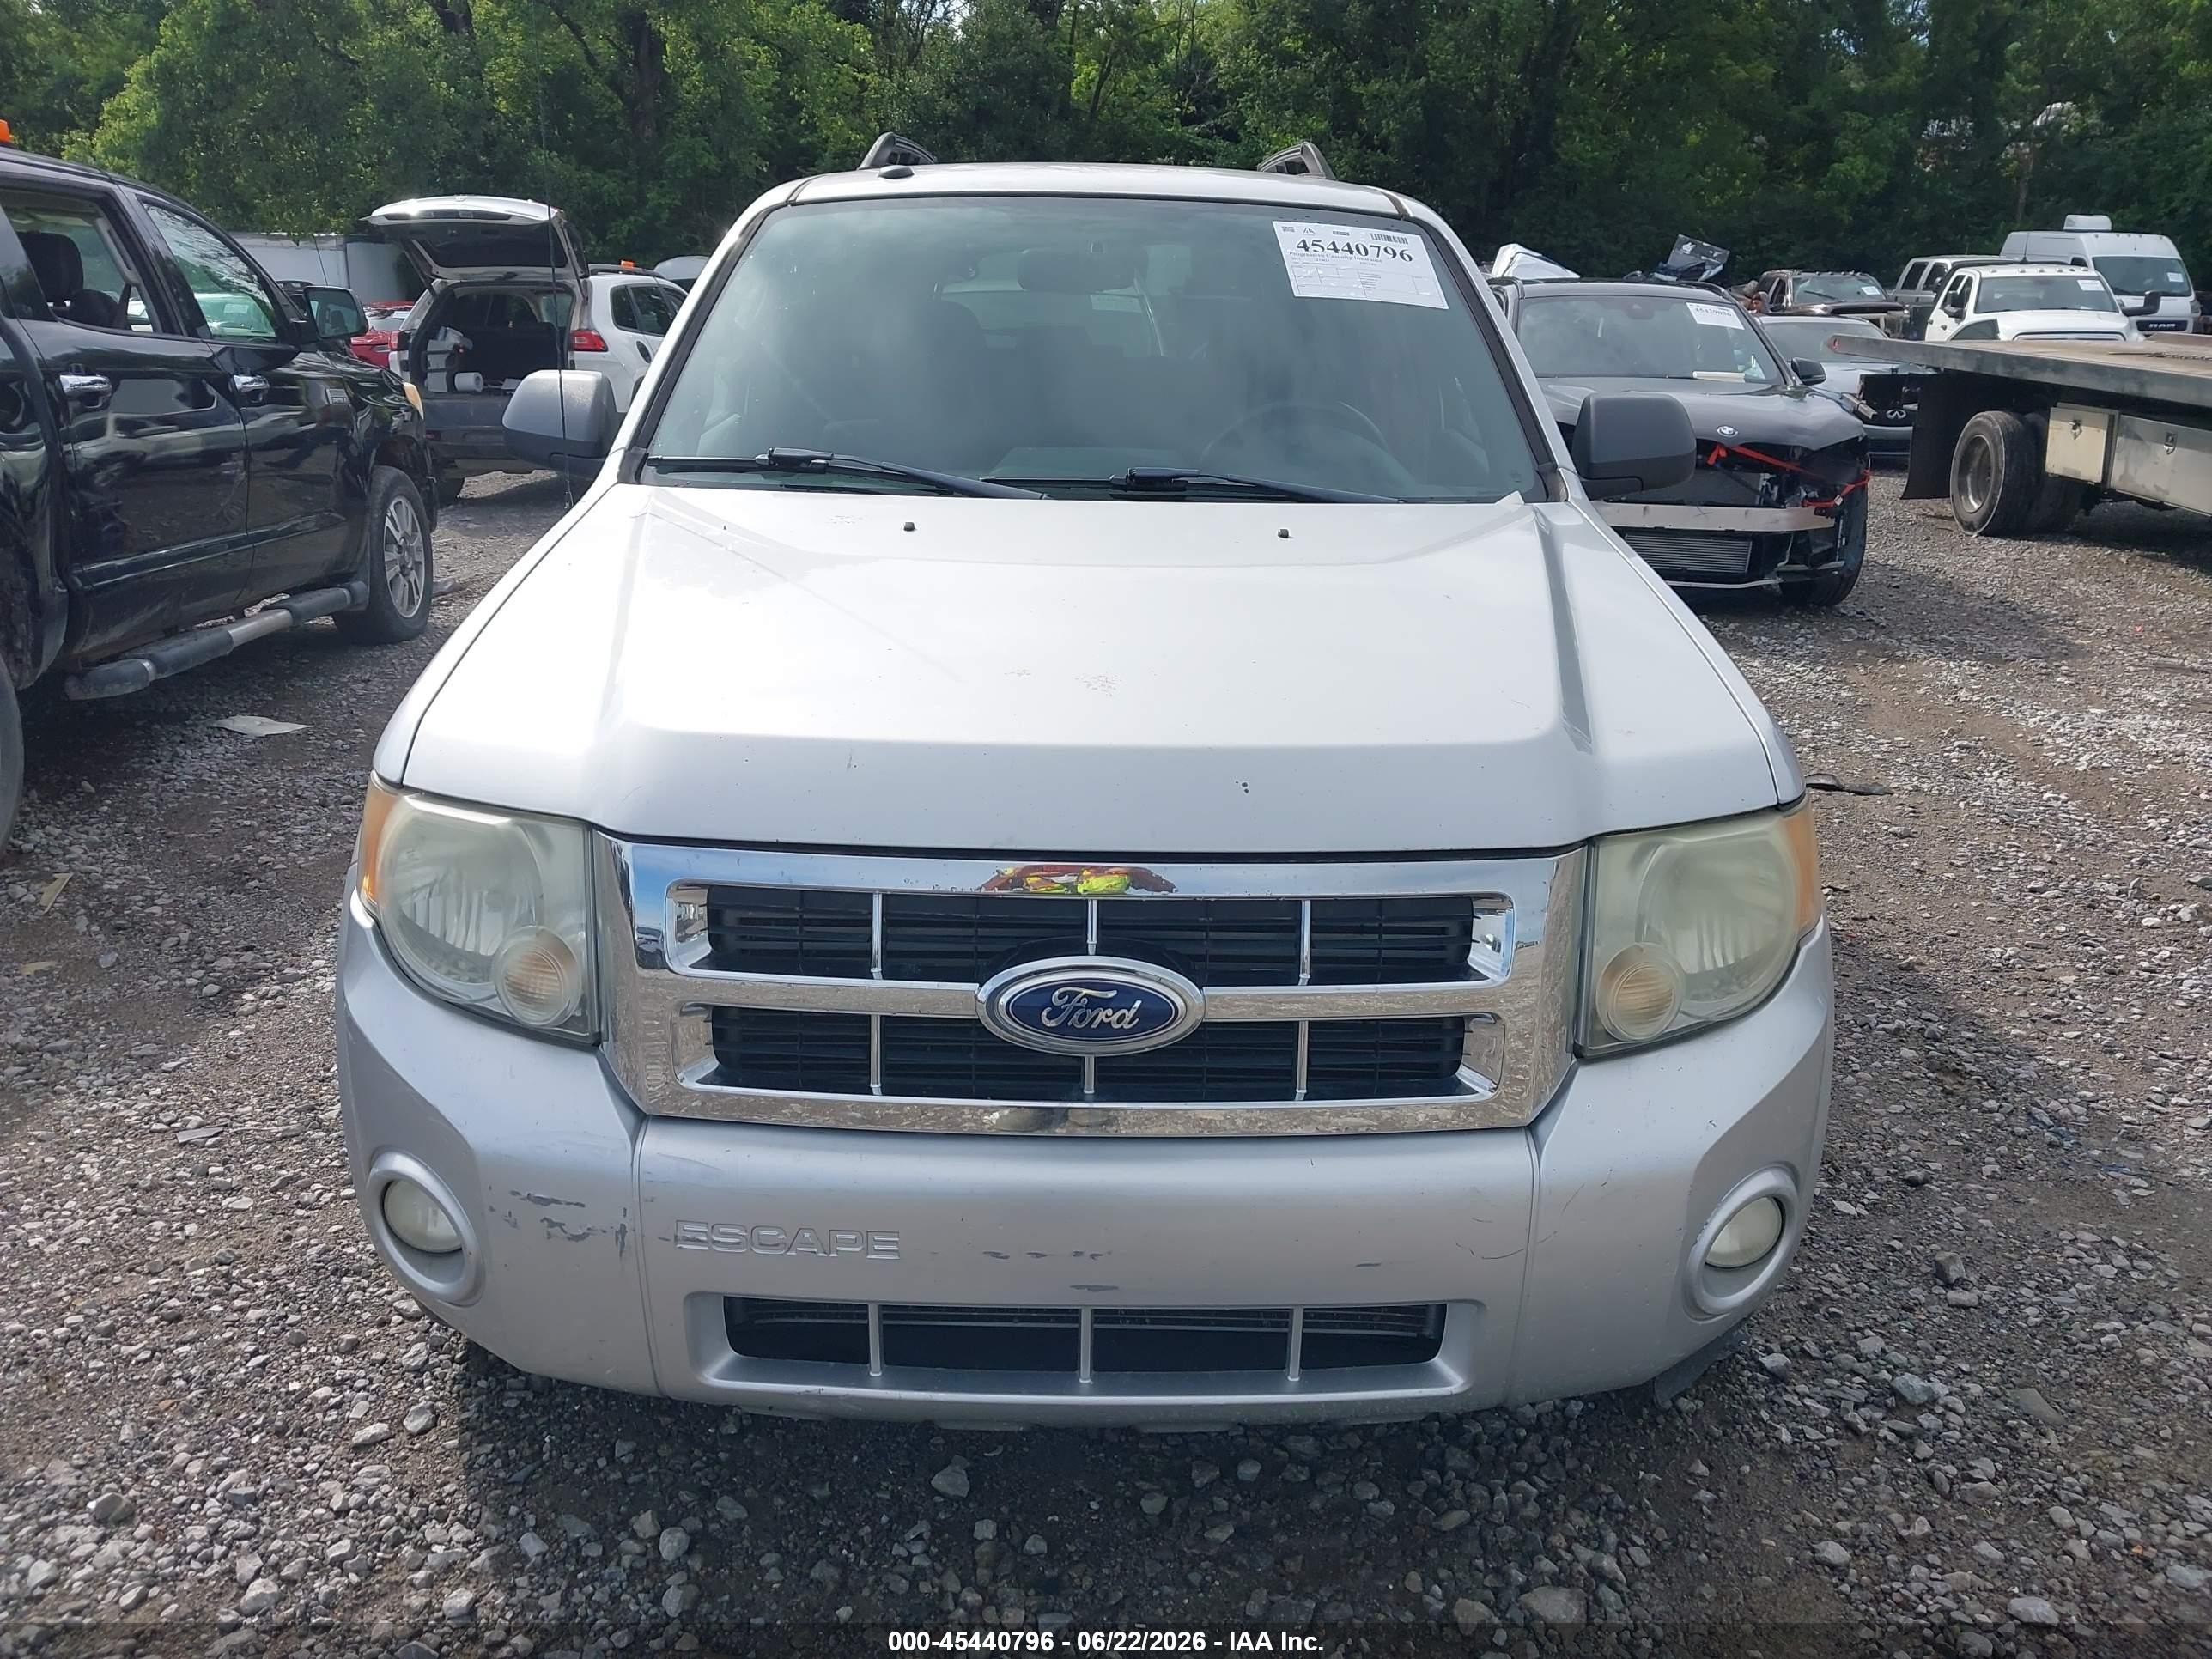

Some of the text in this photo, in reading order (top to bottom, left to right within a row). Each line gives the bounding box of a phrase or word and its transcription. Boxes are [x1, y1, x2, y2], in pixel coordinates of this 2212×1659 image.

[1296, 239, 1413, 262] 45440796
[1041, 986, 1142, 1029] Ford
[675, 1219, 901, 1260] ESCAPE
